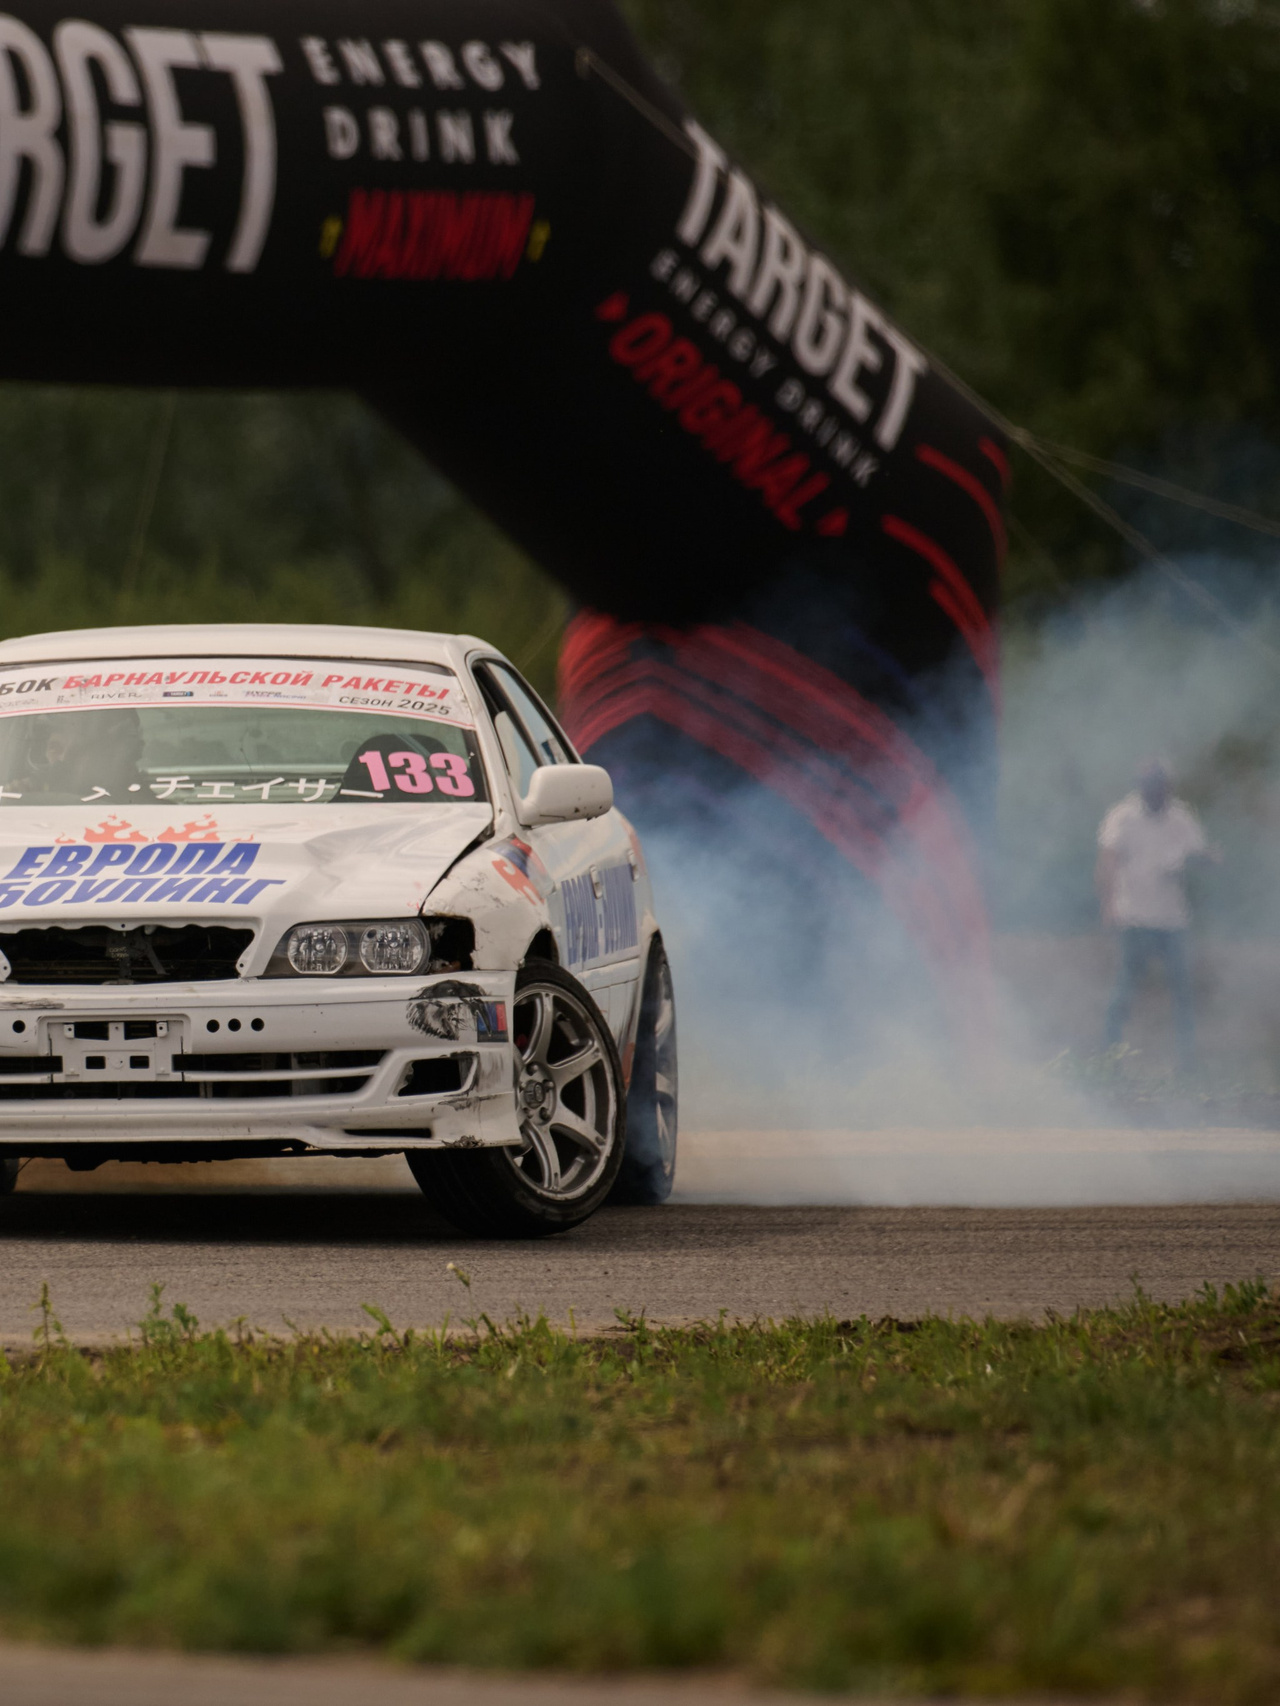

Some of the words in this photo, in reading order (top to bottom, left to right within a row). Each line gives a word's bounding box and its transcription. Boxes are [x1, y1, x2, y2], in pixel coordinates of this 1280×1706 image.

[300, 35, 542, 92] ENERGY
[323, 105, 522, 166] DRINK
[675, 117, 931, 453] TARGET
[649, 246, 778, 380] ENERGY
[774, 376, 880, 489] DRINK
[608, 310, 832, 532] ORIGINAL
[61, 669, 314, 691] БАРНАУЛЬСКОЙ
[321, 674, 450, 700] РАКЕТЫ
[339, 695, 393, 708] СЕЗОН
[396, 699, 453, 716] 2025
[357, 749, 476, 798] 133
[2, 842, 262, 880] ЕВРОПА
